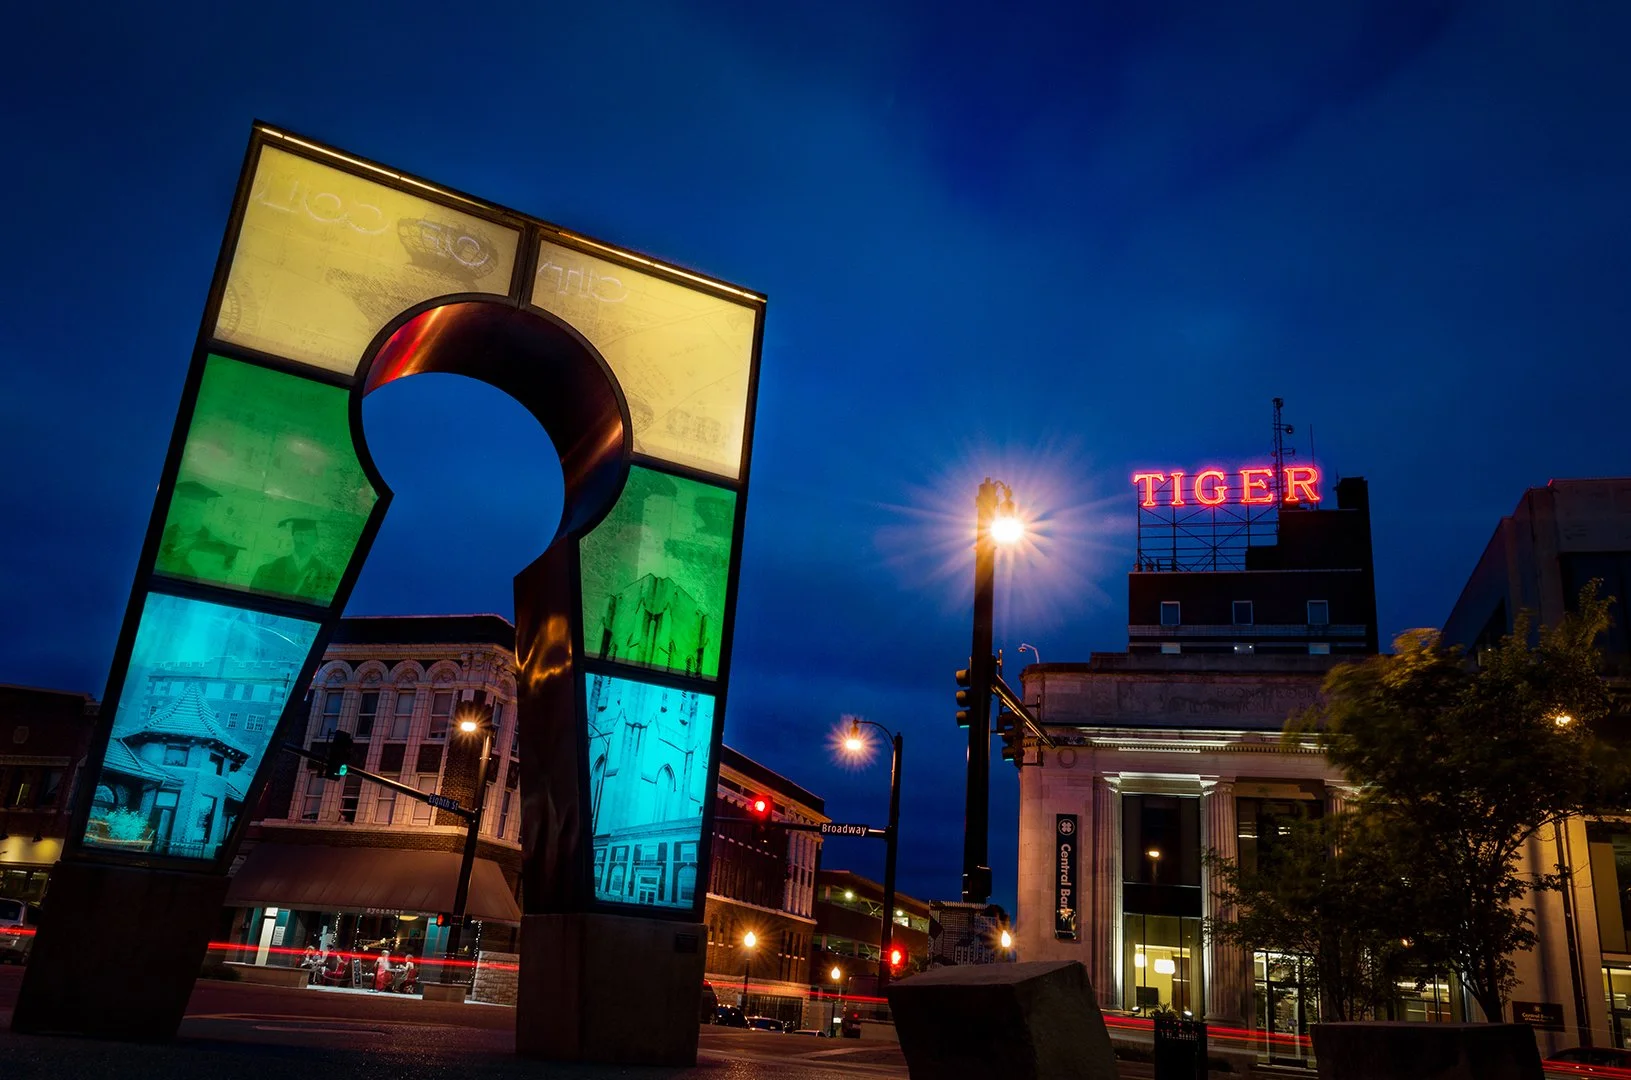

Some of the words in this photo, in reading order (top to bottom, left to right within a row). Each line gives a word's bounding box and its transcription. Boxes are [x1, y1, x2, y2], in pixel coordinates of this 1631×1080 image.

[1133, 466, 1321, 508] TIGER
[821, 823, 867, 837] Broadway
[1060, 843, 1072, 886] Central
